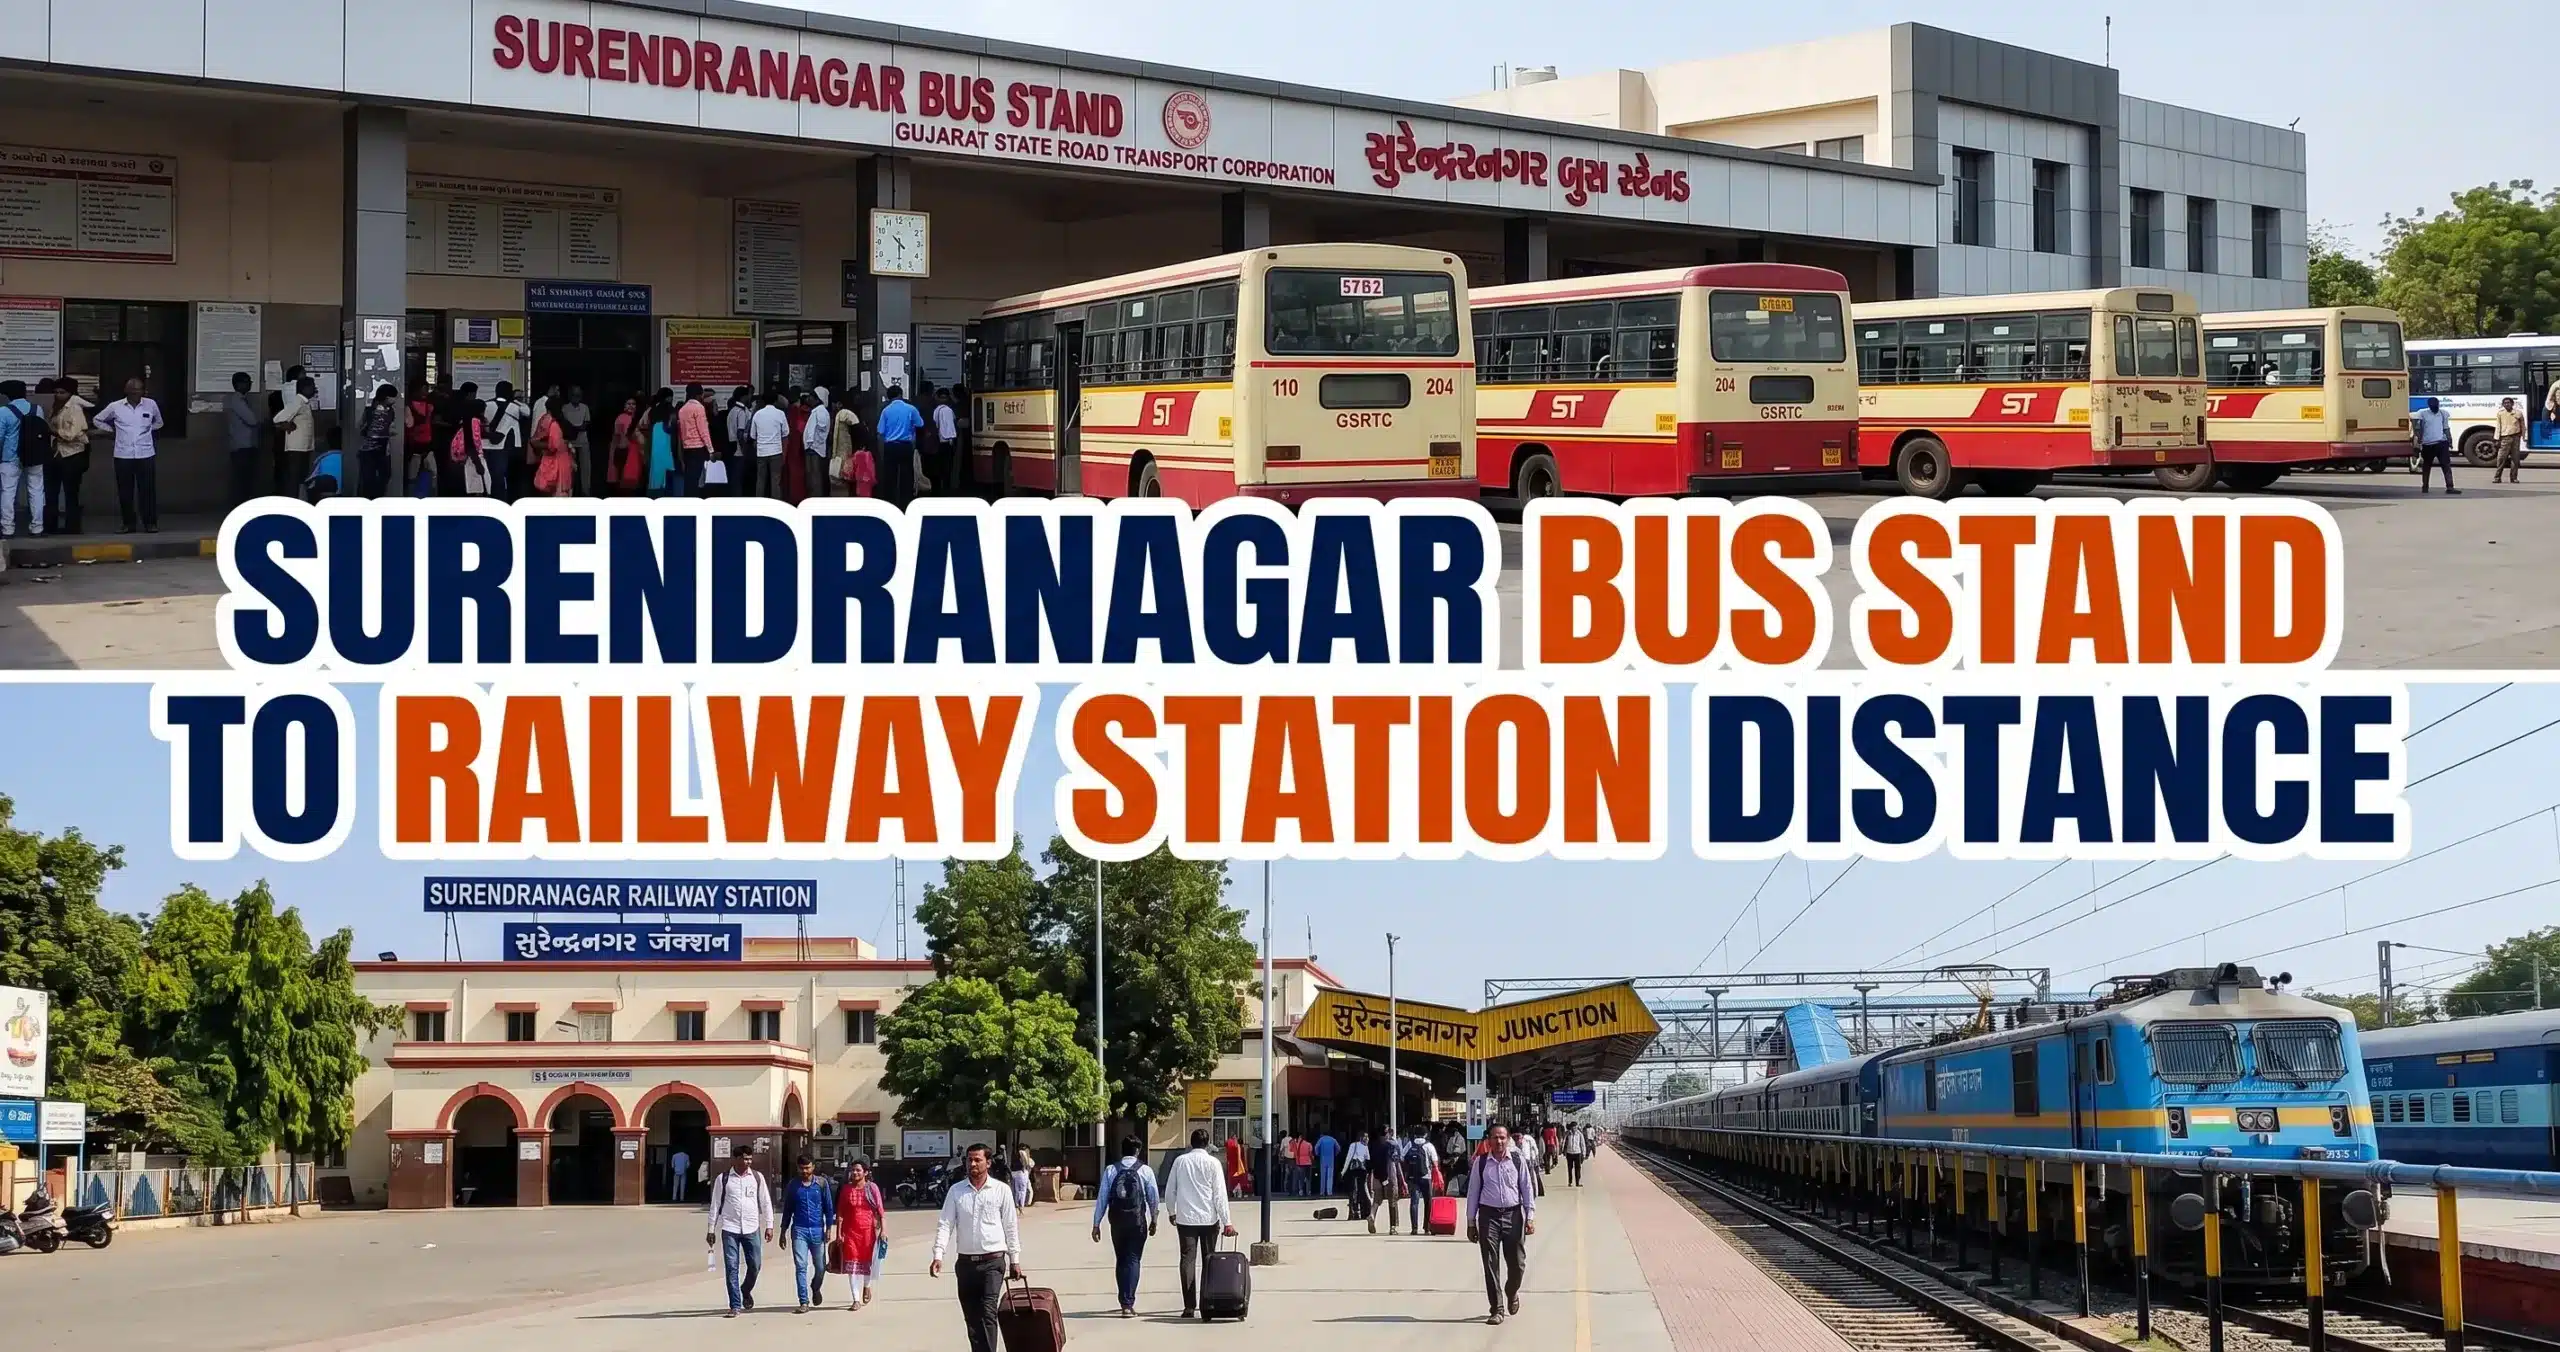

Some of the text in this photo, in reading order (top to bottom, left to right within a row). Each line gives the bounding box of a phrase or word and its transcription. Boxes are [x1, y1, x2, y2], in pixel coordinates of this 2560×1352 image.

[493, 15, 907, 115] SURENDRANAGAR
[919, 71, 996, 124] BUS
[1006, 82, 1124, 138] STAND
[895, 122, 1335, 186] GUJARAT STATE ROAD TRANSPORT CORPORATION
[1272, 378, 1298, 396] 110
[1426, 377, 1454, 395] 204
[1715, 377, 1736, 392] 204
[1152, 397, 1176, 427] ST
[1550, 394, 1584, 419] ST
[1760, 405, 1803, 419] GSRTC
[1999, 392, 2039, 415] ST
[1336, 412, 1393, 428] GSRTC
[429, 883, 811, 908] SURENDRANAGAR RAILWAY STATION
[1497, 1001, 1618, 1043] JUNCTION
